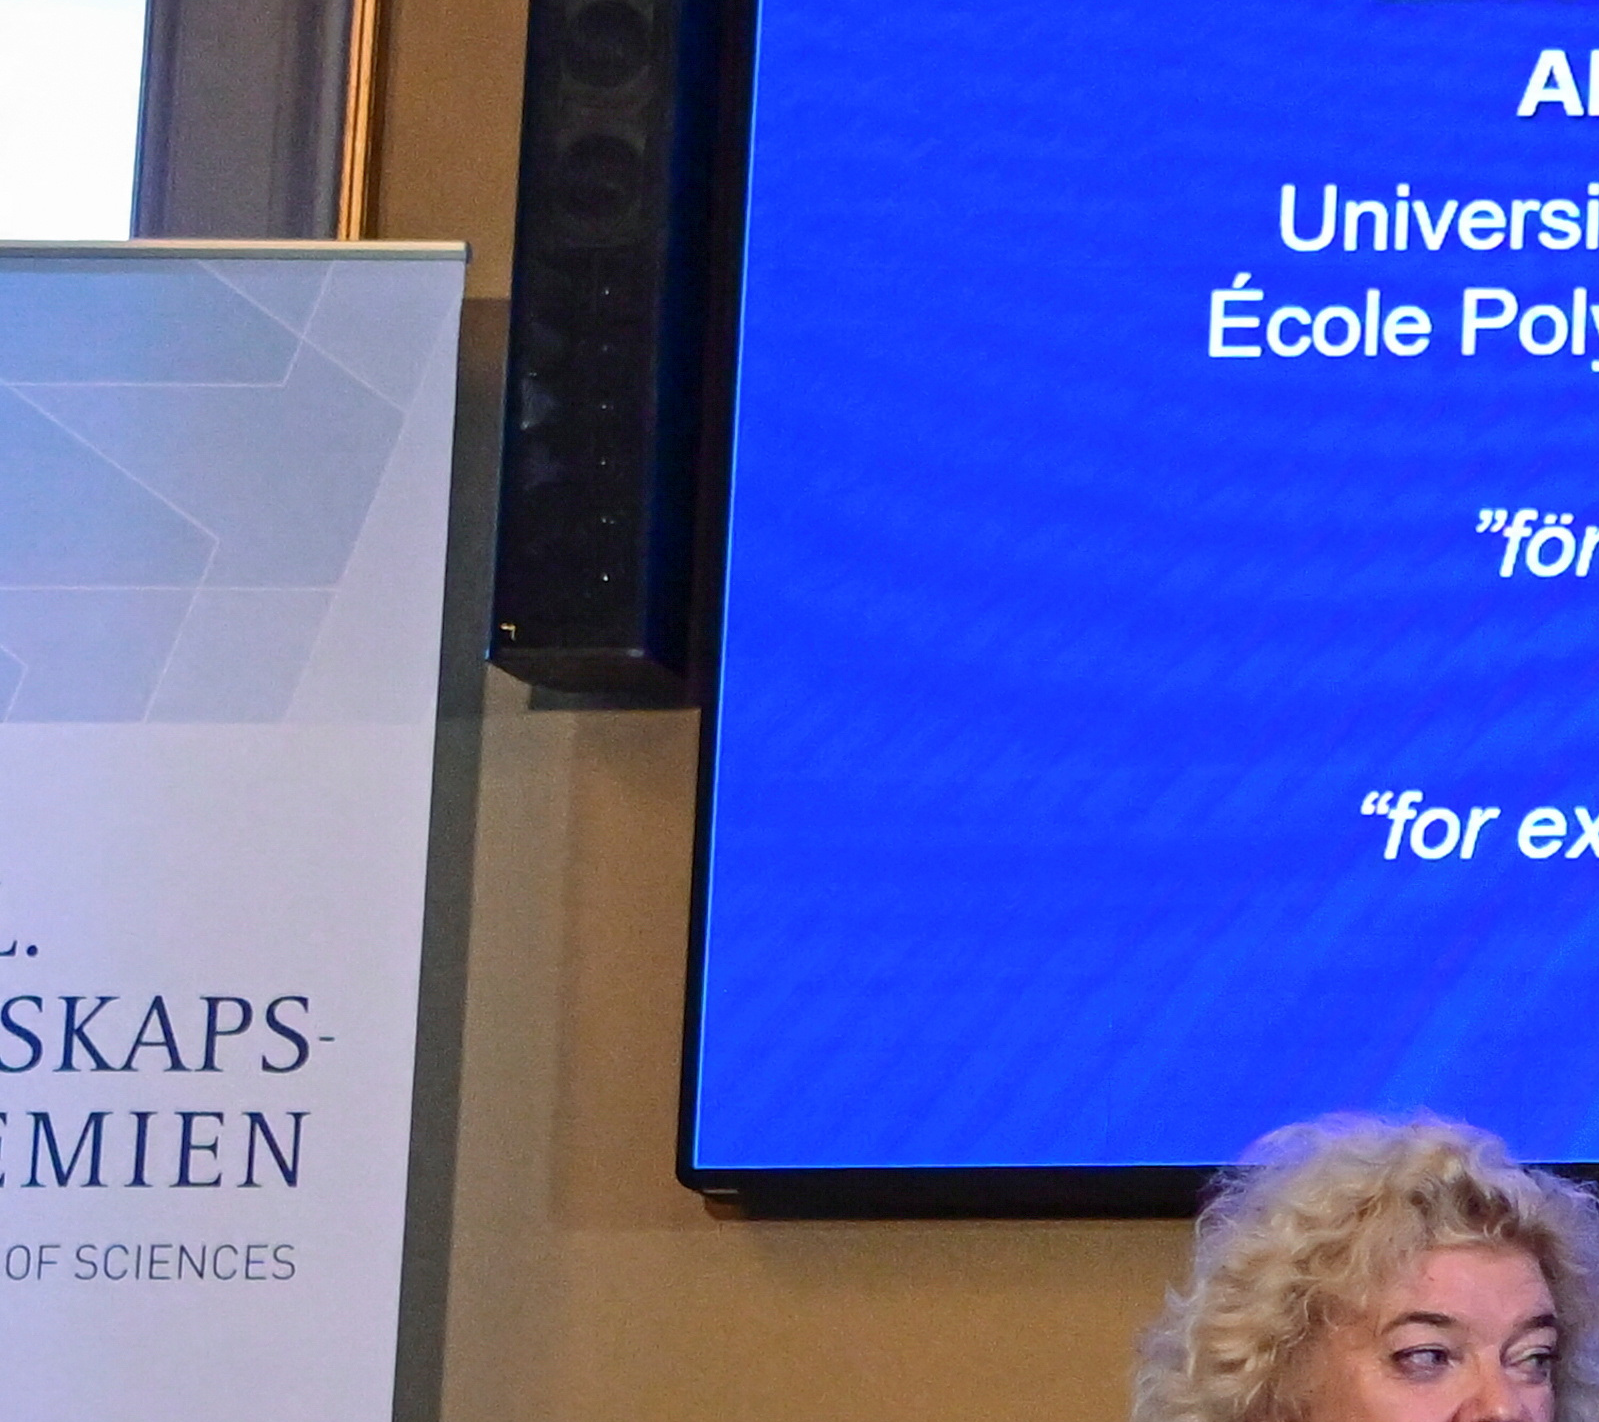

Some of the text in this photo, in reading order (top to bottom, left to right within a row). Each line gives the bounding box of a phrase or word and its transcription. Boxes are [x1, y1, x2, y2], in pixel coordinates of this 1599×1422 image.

[1209, 273, 1431, 357] École
[0, 1112, 309, 1187] MIEN
[5, 1244, 295, 1280] OF SCIENCES
